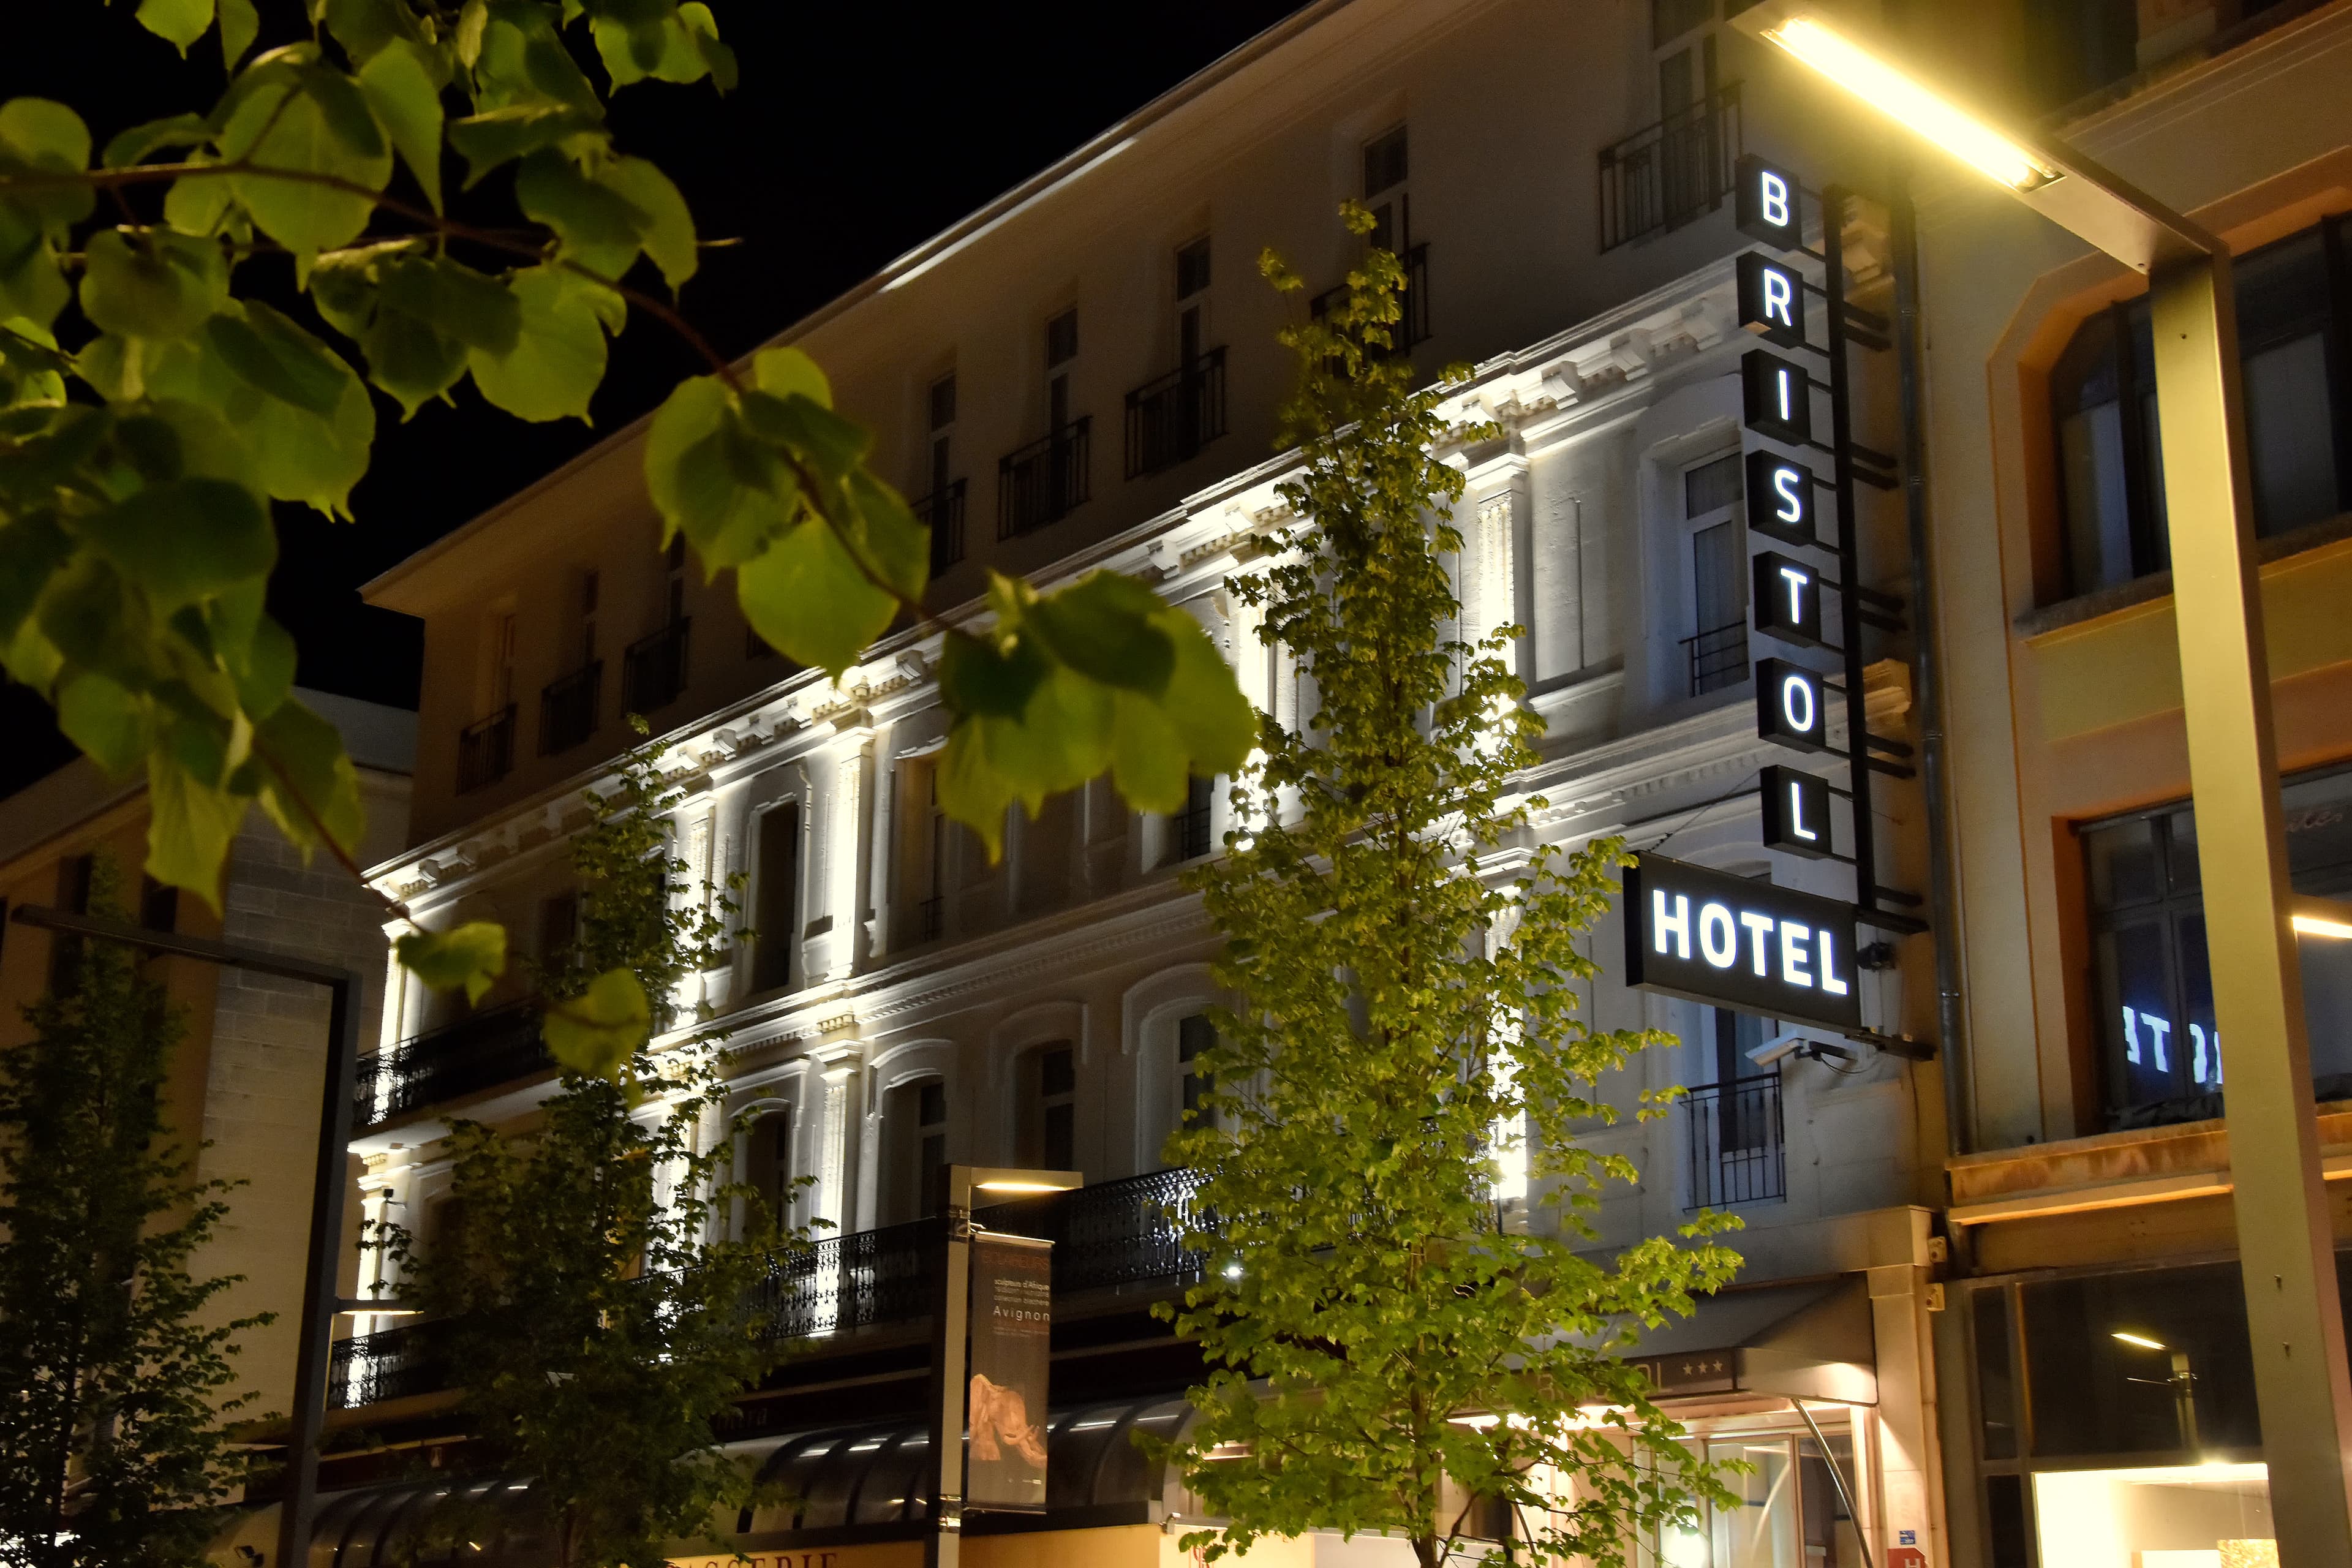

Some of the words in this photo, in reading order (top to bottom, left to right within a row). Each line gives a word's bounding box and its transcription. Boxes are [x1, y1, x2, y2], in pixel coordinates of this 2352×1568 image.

[1761, 171, 1817, 841] BRISTOL
[1652, 888, 1849, 997] HOTEL
[993, 1305, 1050, 1321] Avignon
